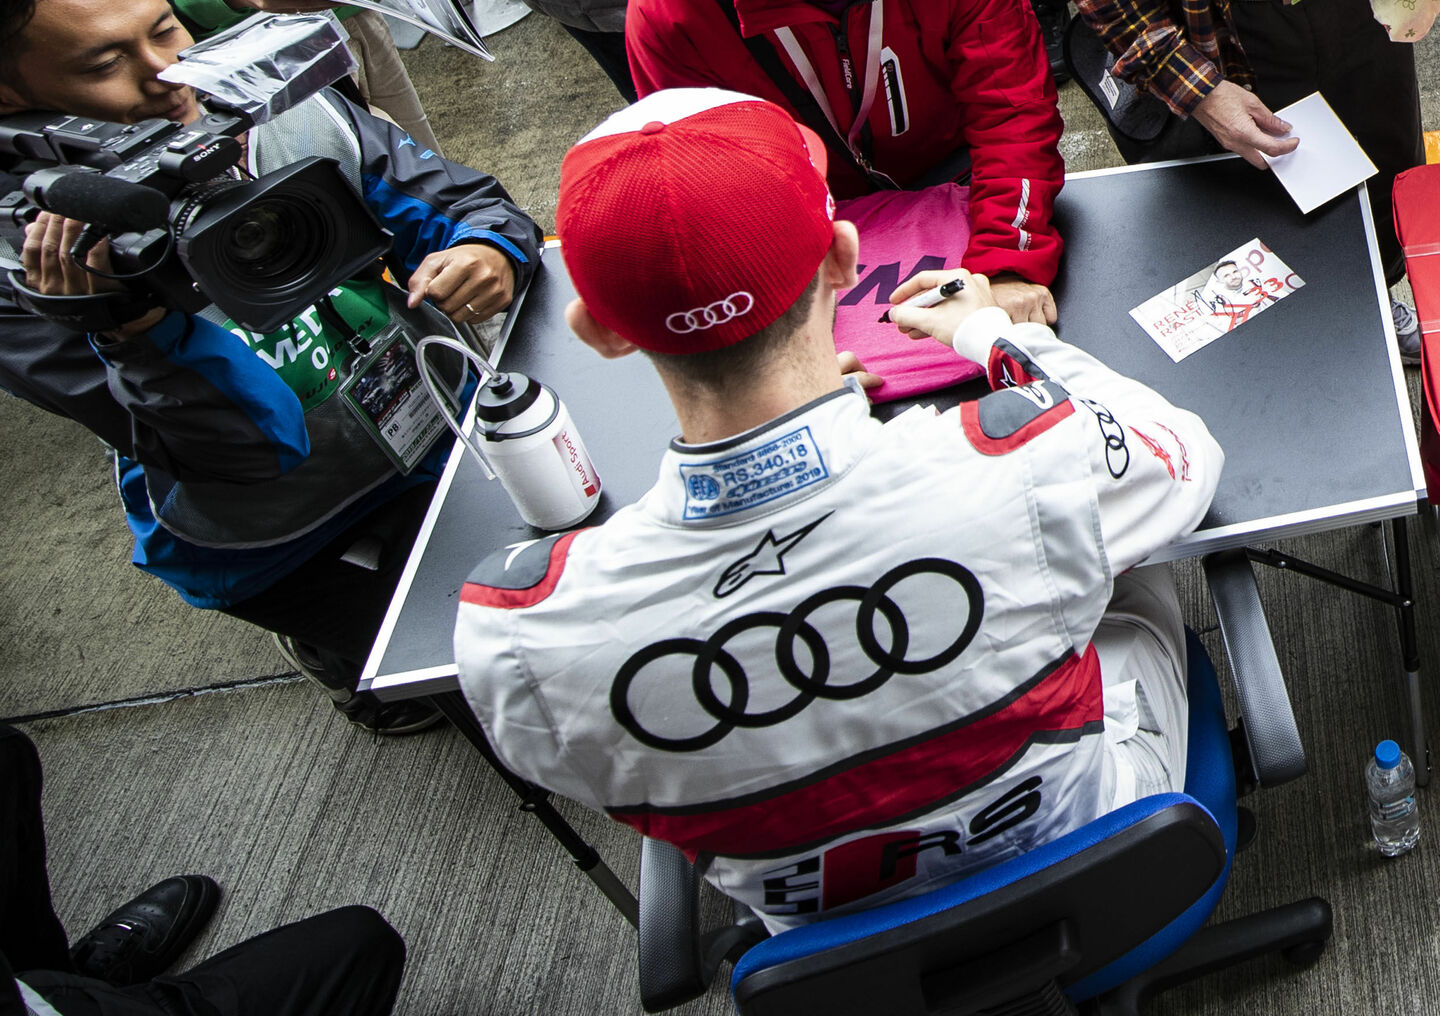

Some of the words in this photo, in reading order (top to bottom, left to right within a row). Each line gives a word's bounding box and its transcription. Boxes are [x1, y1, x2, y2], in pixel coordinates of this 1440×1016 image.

[193, 143, 220, 162] SONY
[561, 431, 578, 463] Sport
[575, 461, 590, 485] Audi
[722, 443, 808, 486] RS.340.18
[796, 467, 821, 485] 2019
